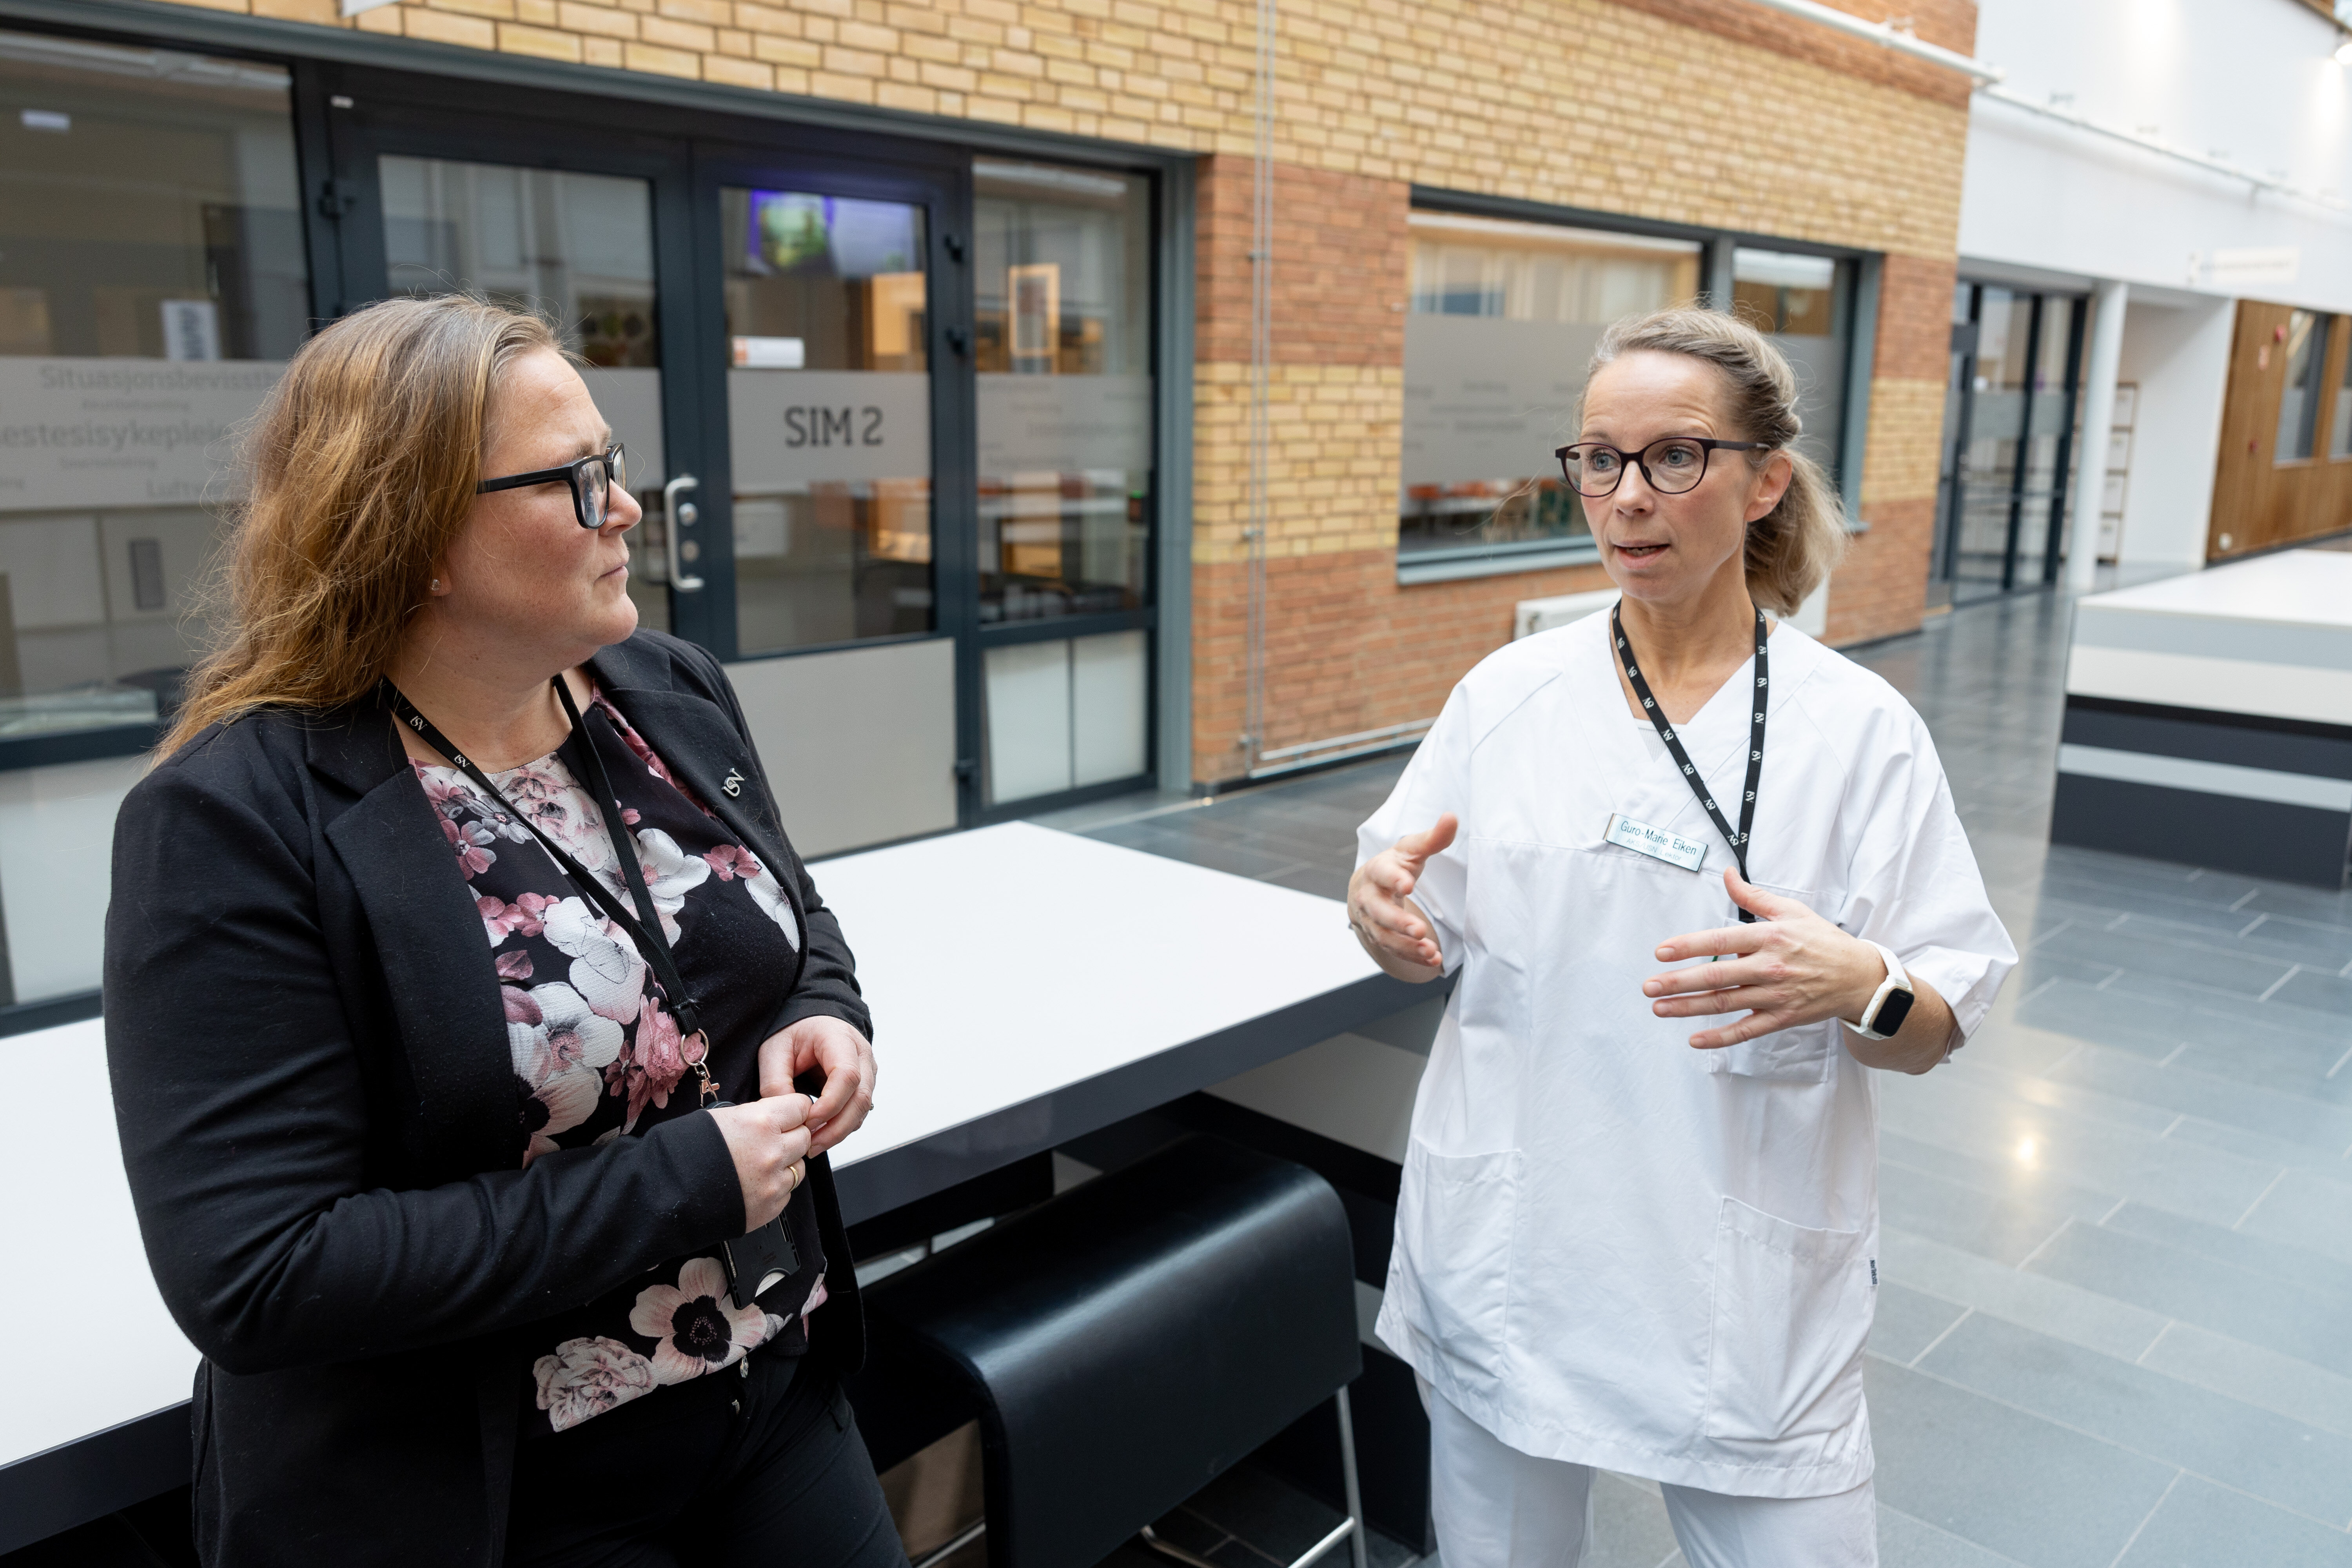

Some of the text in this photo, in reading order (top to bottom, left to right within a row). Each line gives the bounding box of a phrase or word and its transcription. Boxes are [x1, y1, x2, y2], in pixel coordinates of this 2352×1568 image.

[785, 405, 883, 448] SIM 2
[410, 716, 427, 731] USN
[454, 755, 470, 768] USN
[721, 768, 745, 797] USN
[1621, 821, 1697, 855] Guro-Marie Eiken
[1627, 838, 1682, 861] AKS/USN Lektor
